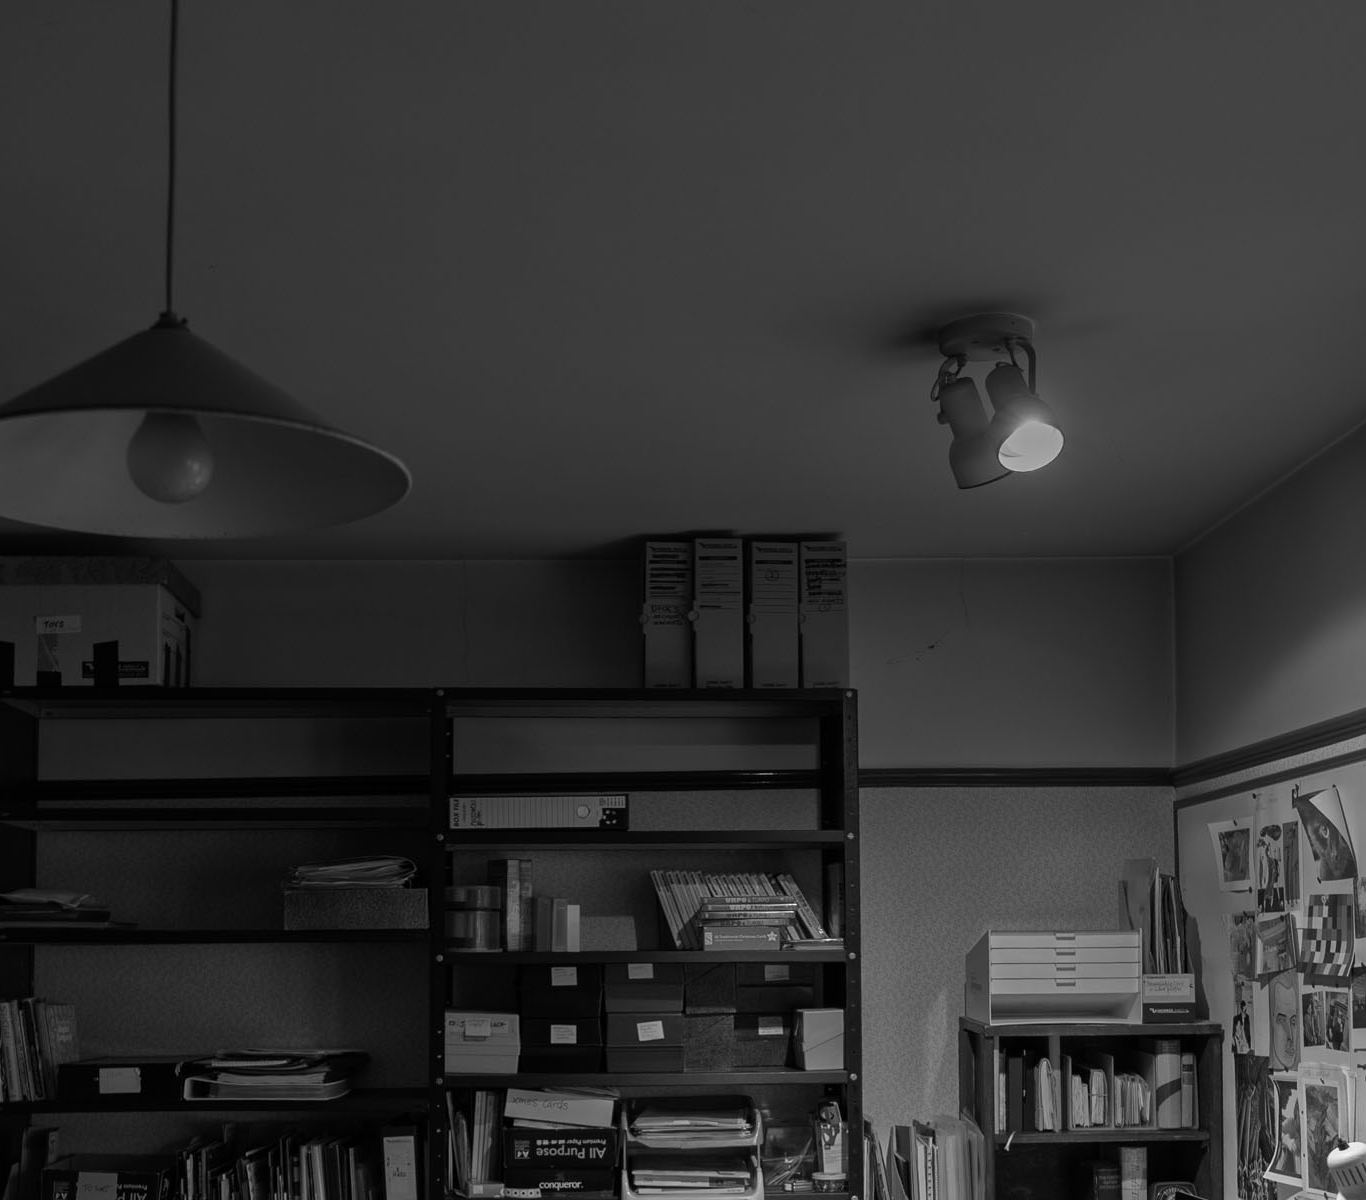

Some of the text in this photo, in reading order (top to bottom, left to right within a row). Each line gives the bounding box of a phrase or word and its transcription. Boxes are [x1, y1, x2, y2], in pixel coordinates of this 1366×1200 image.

[452, 814, 460, 828] BOX
[536, 1145, 586, 1159] Purpose
[589, 1147, 607, 1159] All
[539, 1181, 584, 1191] conqueror.
